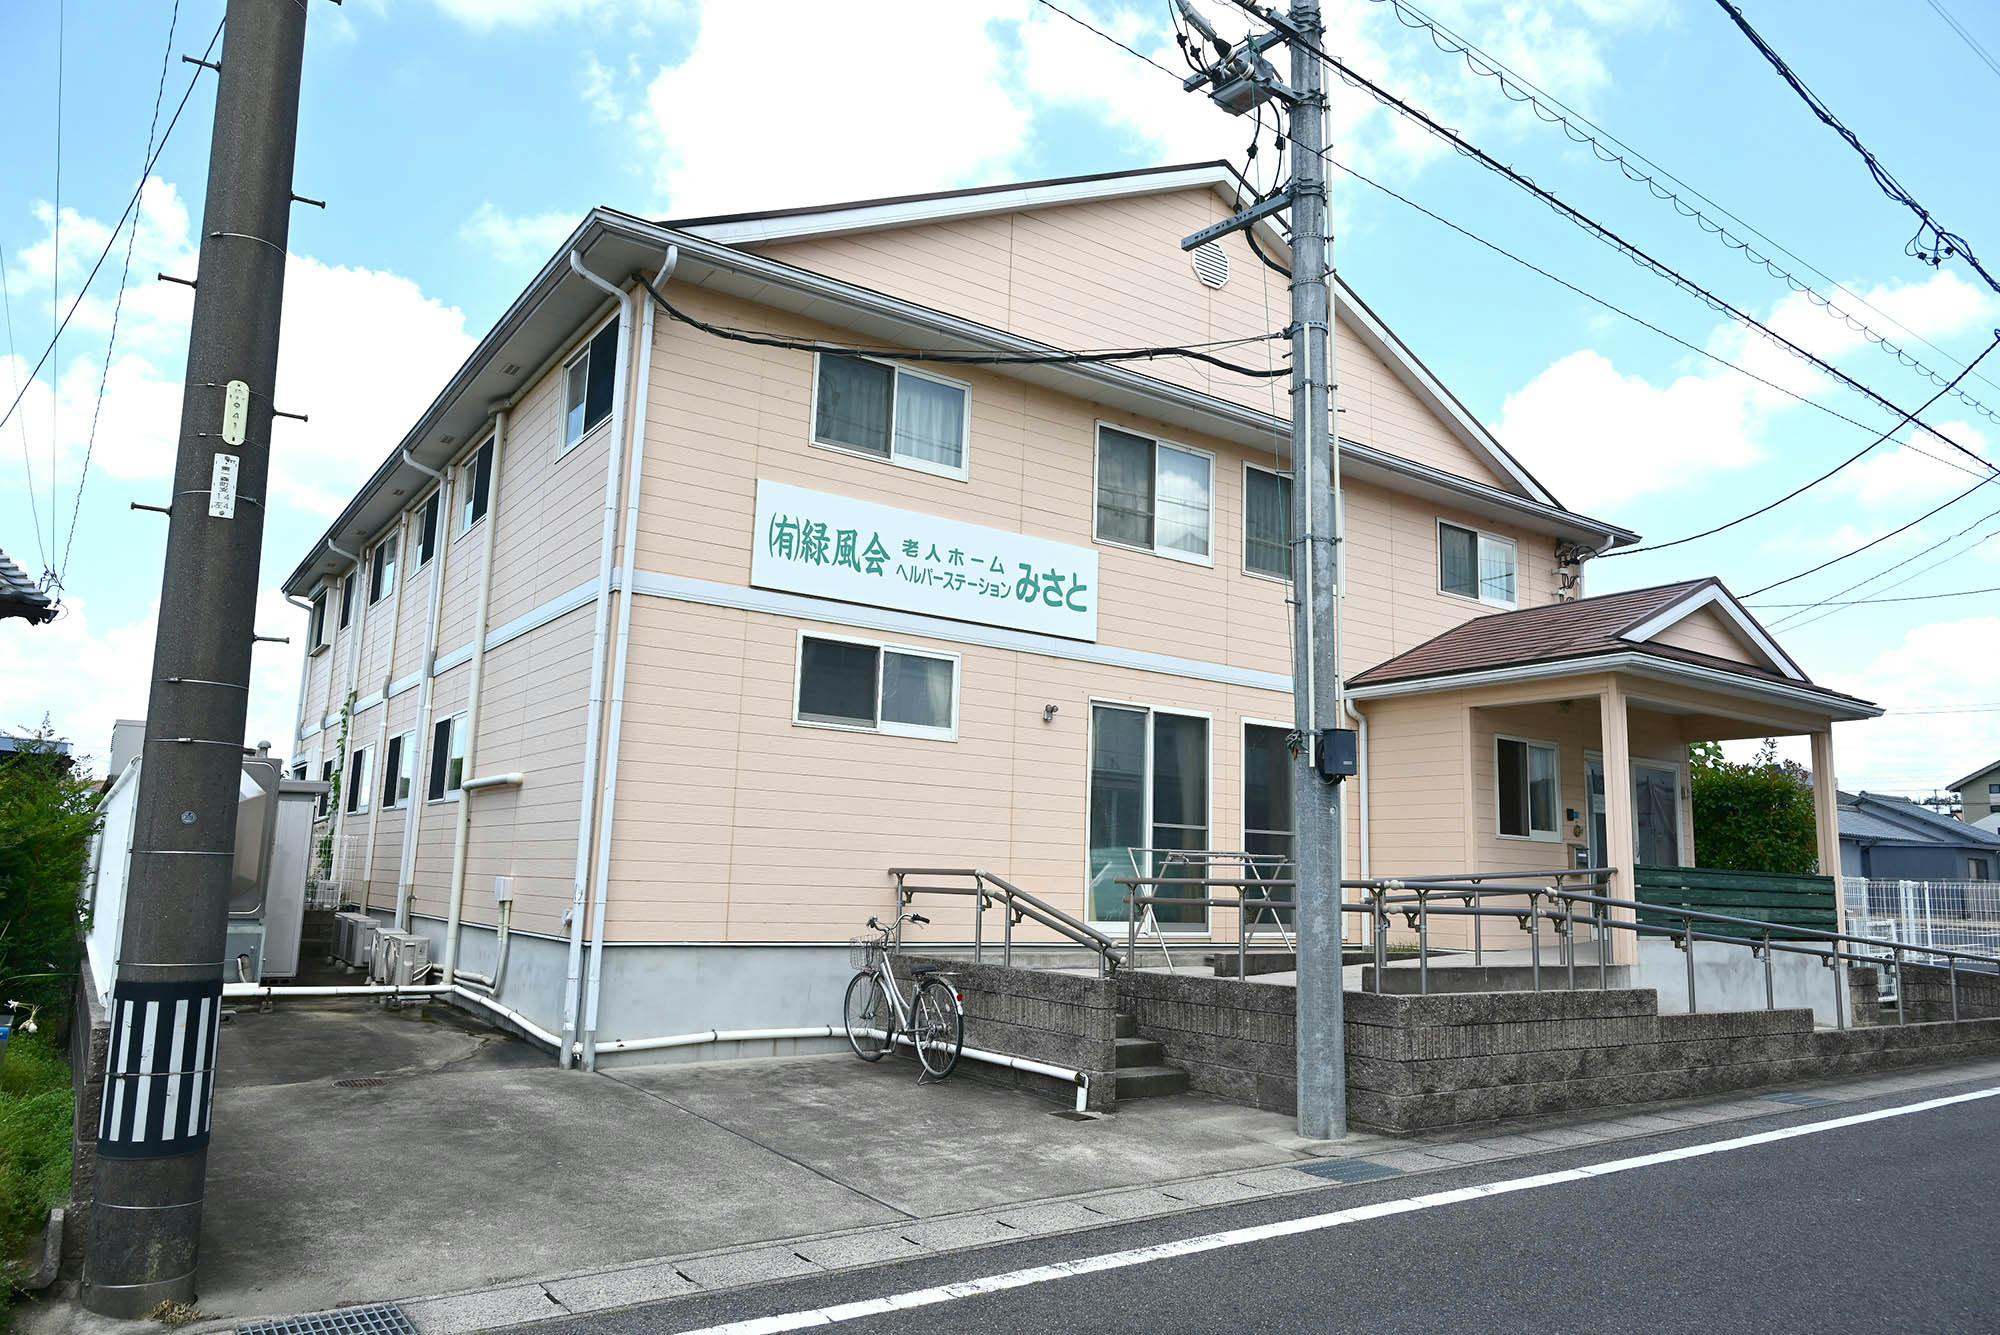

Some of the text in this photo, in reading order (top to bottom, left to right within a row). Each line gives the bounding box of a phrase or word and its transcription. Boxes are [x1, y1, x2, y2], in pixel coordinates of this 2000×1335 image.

[769, 512, 890, 577] (有)緑風会
[901, 538, 1005, 575] 老人ホーム
[895, 563, 1012, 599] ヘルパーステーション
[1015, 562, 1089, 613] みさと
